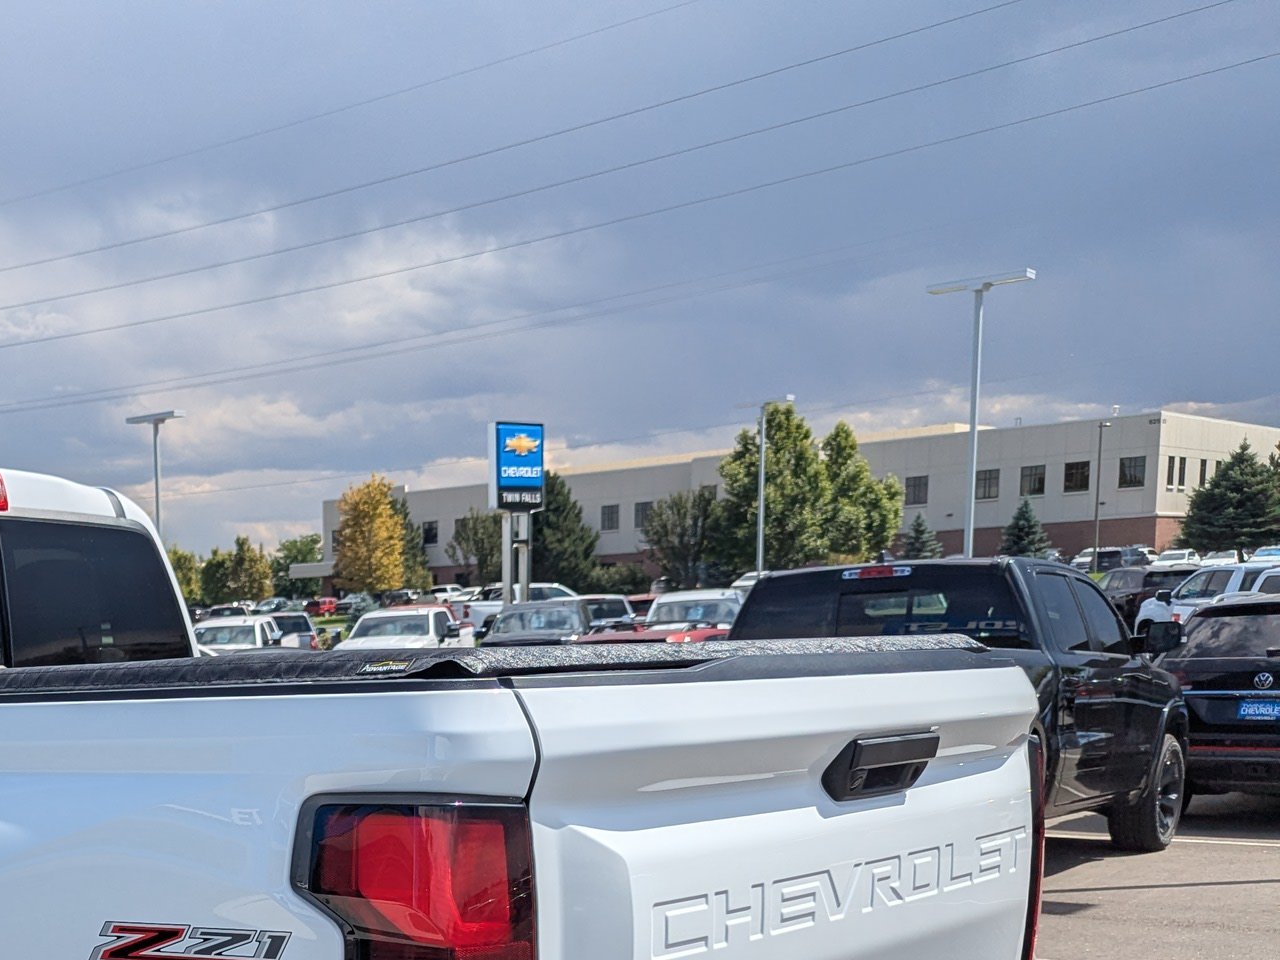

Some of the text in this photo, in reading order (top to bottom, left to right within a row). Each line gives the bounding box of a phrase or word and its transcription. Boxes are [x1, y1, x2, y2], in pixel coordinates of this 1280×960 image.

[501, 466, 542, 478] CHEVROLET
[502, 492, 541, 503] TWIN FALLS
[360, 664, 407, 673] ADVANTAGE
